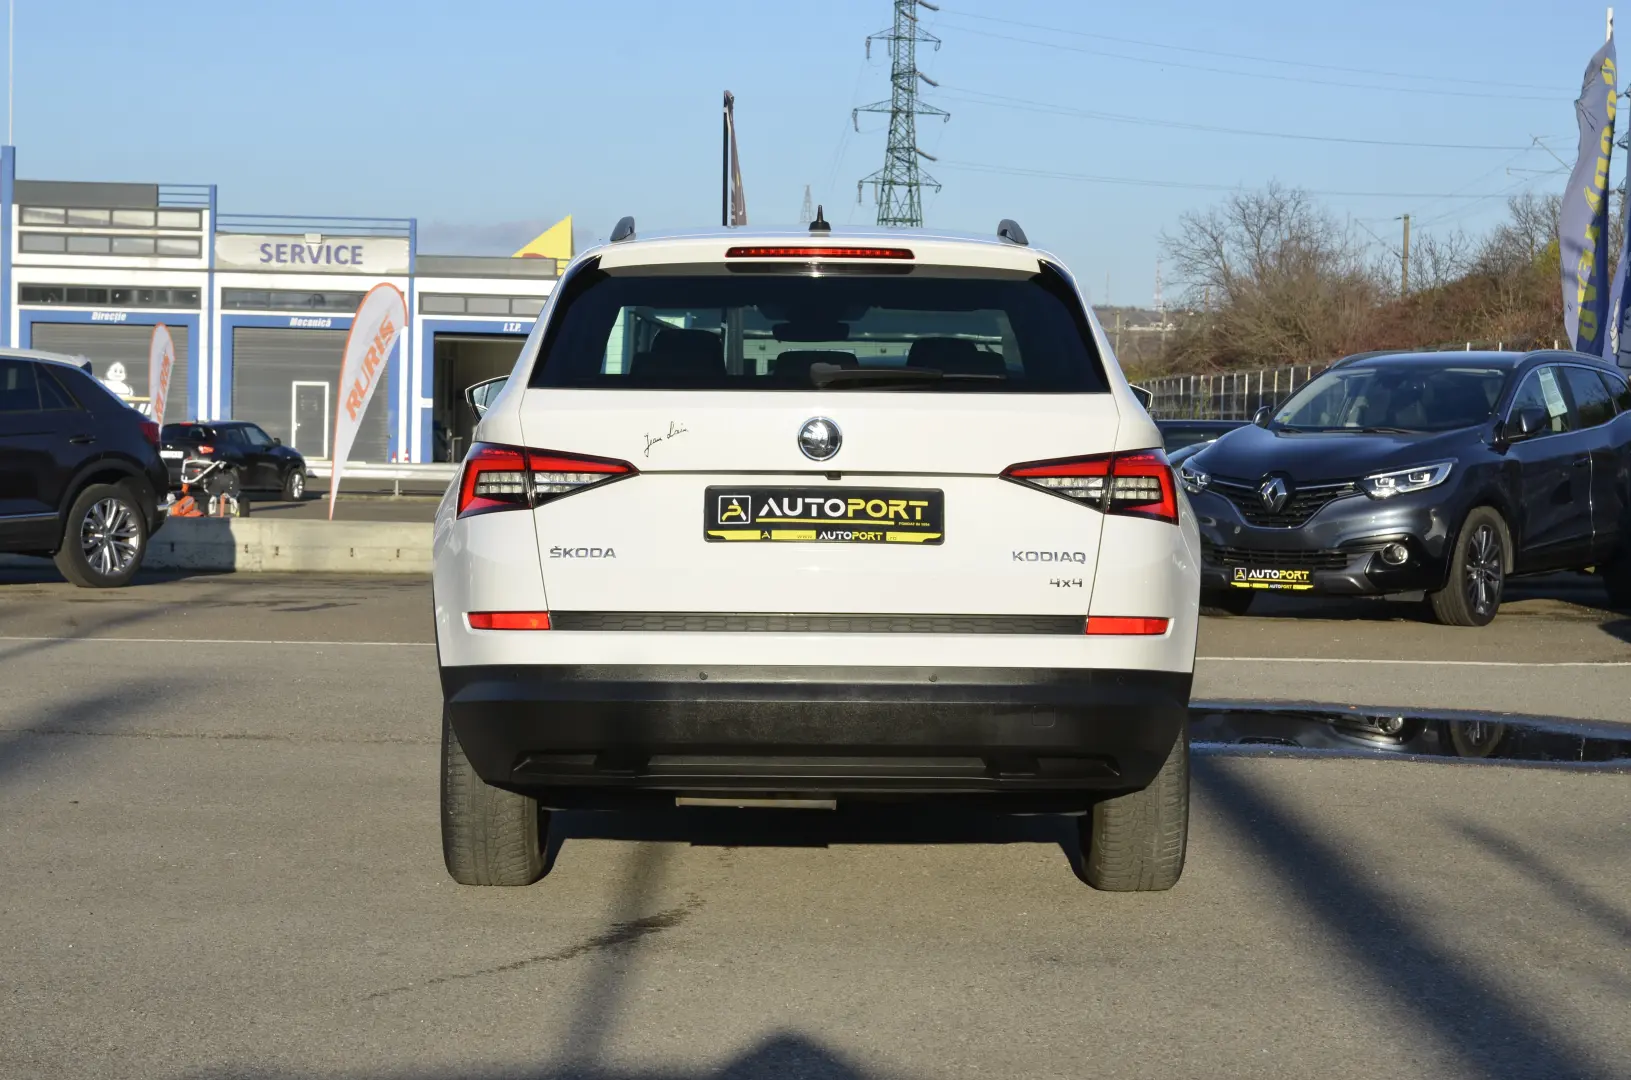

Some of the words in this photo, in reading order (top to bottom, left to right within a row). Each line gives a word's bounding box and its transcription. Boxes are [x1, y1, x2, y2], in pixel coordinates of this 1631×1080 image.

[259, 243, 364, 265] SERVICE
[346, 314, 395, 422] RURIS
[758, 497, 929, 520] AUTOPORT
[819, 530, 883, 541] AUTOPORT
[549, 546, 616, 559] ŠKODA
[1012, 551, 1087, 564] KODIAQ
[1248, 569, 1310, 580] AUTOPORT
[1049, 578, 1083, 588] 4x4
